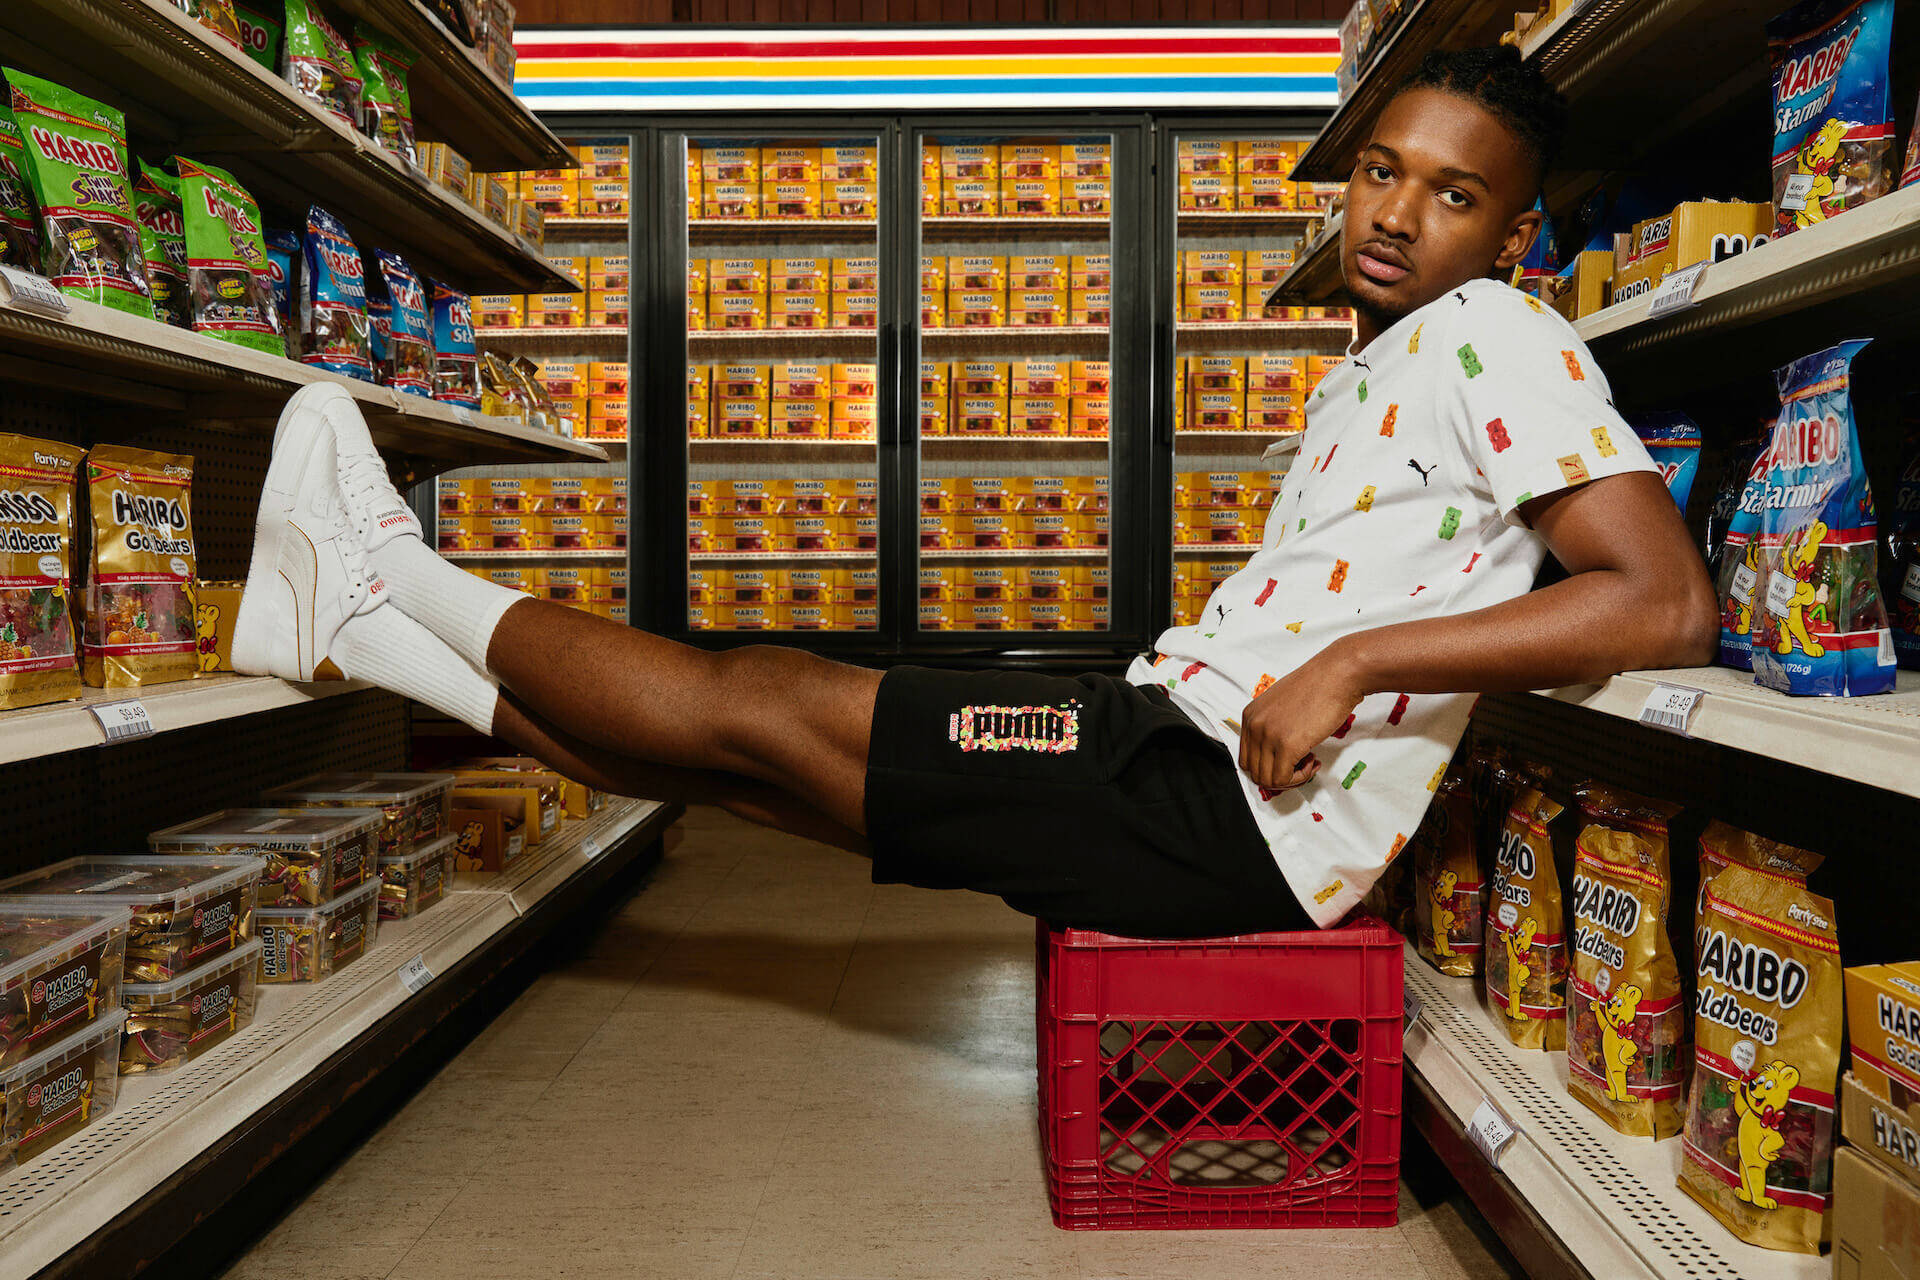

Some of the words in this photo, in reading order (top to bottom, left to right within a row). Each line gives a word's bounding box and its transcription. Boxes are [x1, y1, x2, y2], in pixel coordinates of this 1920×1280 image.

[1774, 87, 1830, 137] Starmi
[1191, 178, 1221, 186] HARIBO
[1252, 178, 1281, 186] HARIBO
[593, 184, 623, 192] HARIBO
[776, 186, 806, 194] HARIBO
[1075, 183, 1105, 191] HARIBO
[1261, 252, 1291, 260] HARIBO
[786, 260, 816, 268] HARIBO
[963, 258, 993, 266] HARIBO
[481, 296, 511, 304] HARIBO
[724, 298, 753, 306] HARIBO
[963, 295, 993, 303] HARIBO
[544, 365, 575, 373] HARIBO
[726, 367, 756, 375] HARIBO
[965, 364, 995, 372] HARIBO
[1026, 364, 1057, 372] HARIBO
[553, 402, 573, 410] RIBO
[1025, 401, 1055, 409] HARIBO
[34, 452, 58, 468] Party
[1209, 474, 1239, 482] HARIBO
[551, 480, 582, 488] HARIBO
[733, 482, 763, 490] HARIBO
[1033, 479, 1064, 487] HARIBO
[1765, 477, 1834, 510] tarmix
[113, 489, 186, 531] HARIBO
[491, 518, 521, 526] HARIBO
[795, 519, 825, 527] HARIBO
[856, 519, 877, 527] HARI
[973, 517, 1003, 525] HARIBO
[126, 530, 190, 555] Gobears
[491, 571, 521, 579] HARIBO
[791, 572, 821, 580] HARIBO
[791, 608, 822, 616] HARIBO
[1665, 694, 1692, 712] $9.49
[119, 706, 146, 722] $9.49
[949, 713, 960, 742] HARIBO
[968, 709, 1070, 746] PUMA
[202, 901, 232, 928] HARIBO
[1788, 903, 1812, 928] Party
[1811, 915, 1829, 930] size
[263, 926, 275, 976] HARIBO
[1576, 926, 1624, 971] ldbears
[46, 965, 87, 1002] HARIBO
[200, 984, 230, 1015] HARIBO
[41, 1066, 82, 1102] HARIBO
[42, 1088, 79, 1116] Goldbears
